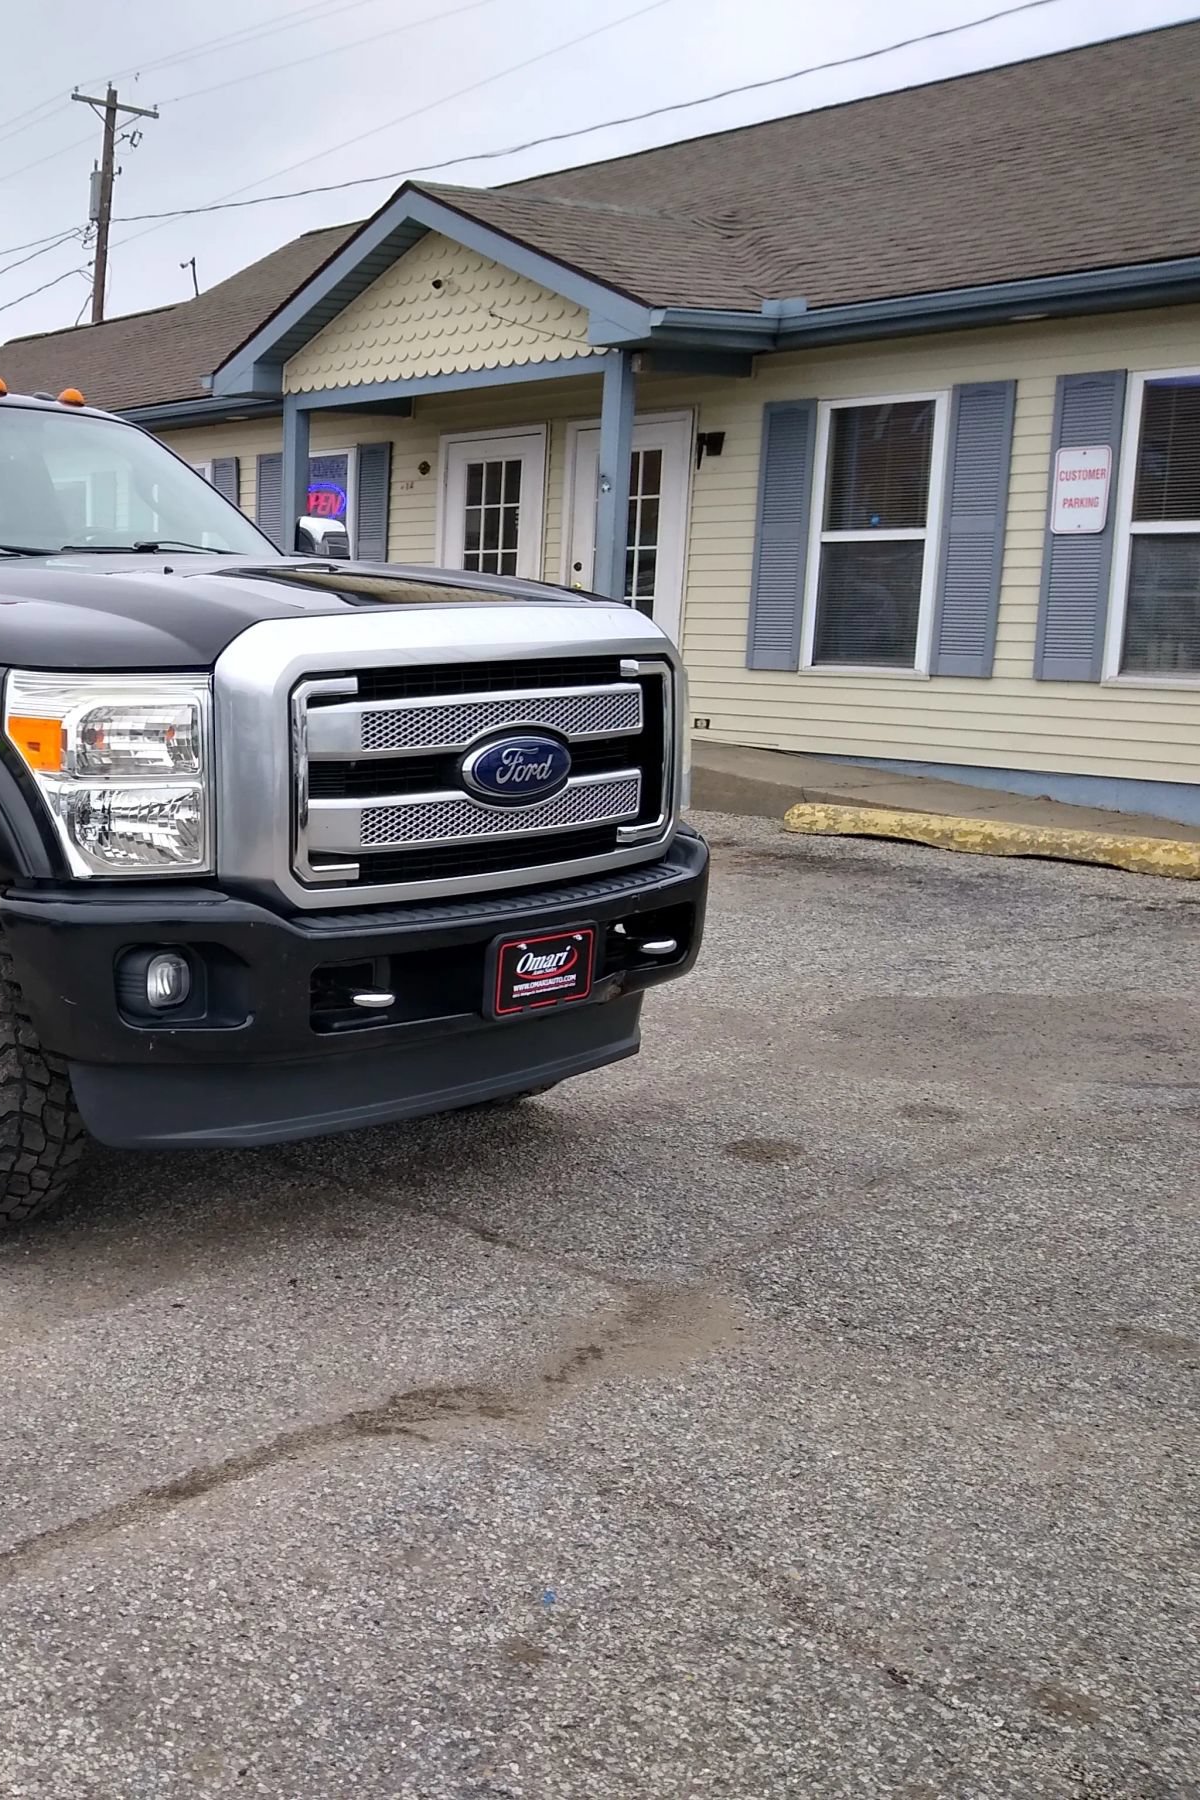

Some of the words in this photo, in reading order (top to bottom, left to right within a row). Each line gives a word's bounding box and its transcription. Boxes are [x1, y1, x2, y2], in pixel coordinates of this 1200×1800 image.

[1059, 468, 1107, 482] CUSTOMER
[307, 491, 341, 516] PEN
[1062, 496, 1100, 509] PARKING
[495, 746, 555, 785] Ford
[516, 945, 572, 974] Omari
